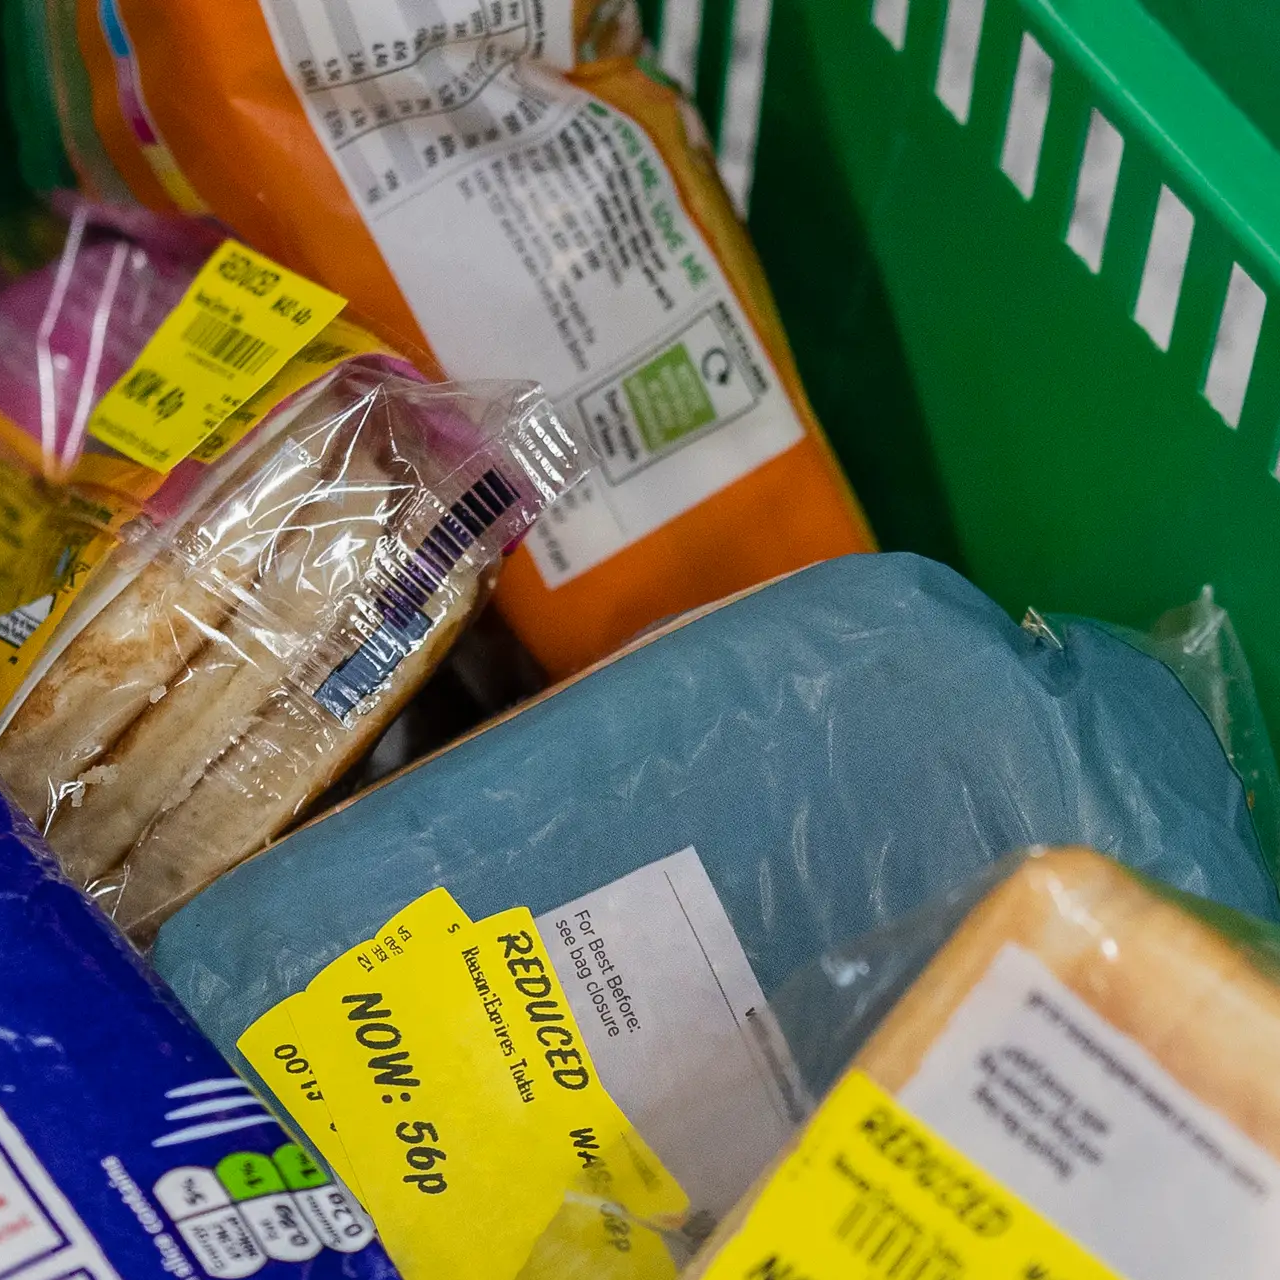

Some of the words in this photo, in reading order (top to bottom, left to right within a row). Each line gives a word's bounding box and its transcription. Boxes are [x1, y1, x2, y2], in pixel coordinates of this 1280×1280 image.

[496, 930, 590, 1091] REDUCED
[554, 919, 576, 947] see
[569, 946, 593, 980] bag
[586, 981, 621, 1037] closure
[574, 909, 596, 936] For
[588, 937, 615, 976] Best
[606, 974, 641, 1033] Before:
[341, 992, 421, 1104] NOW:
[390, 1121, 451, 1195] 56p
